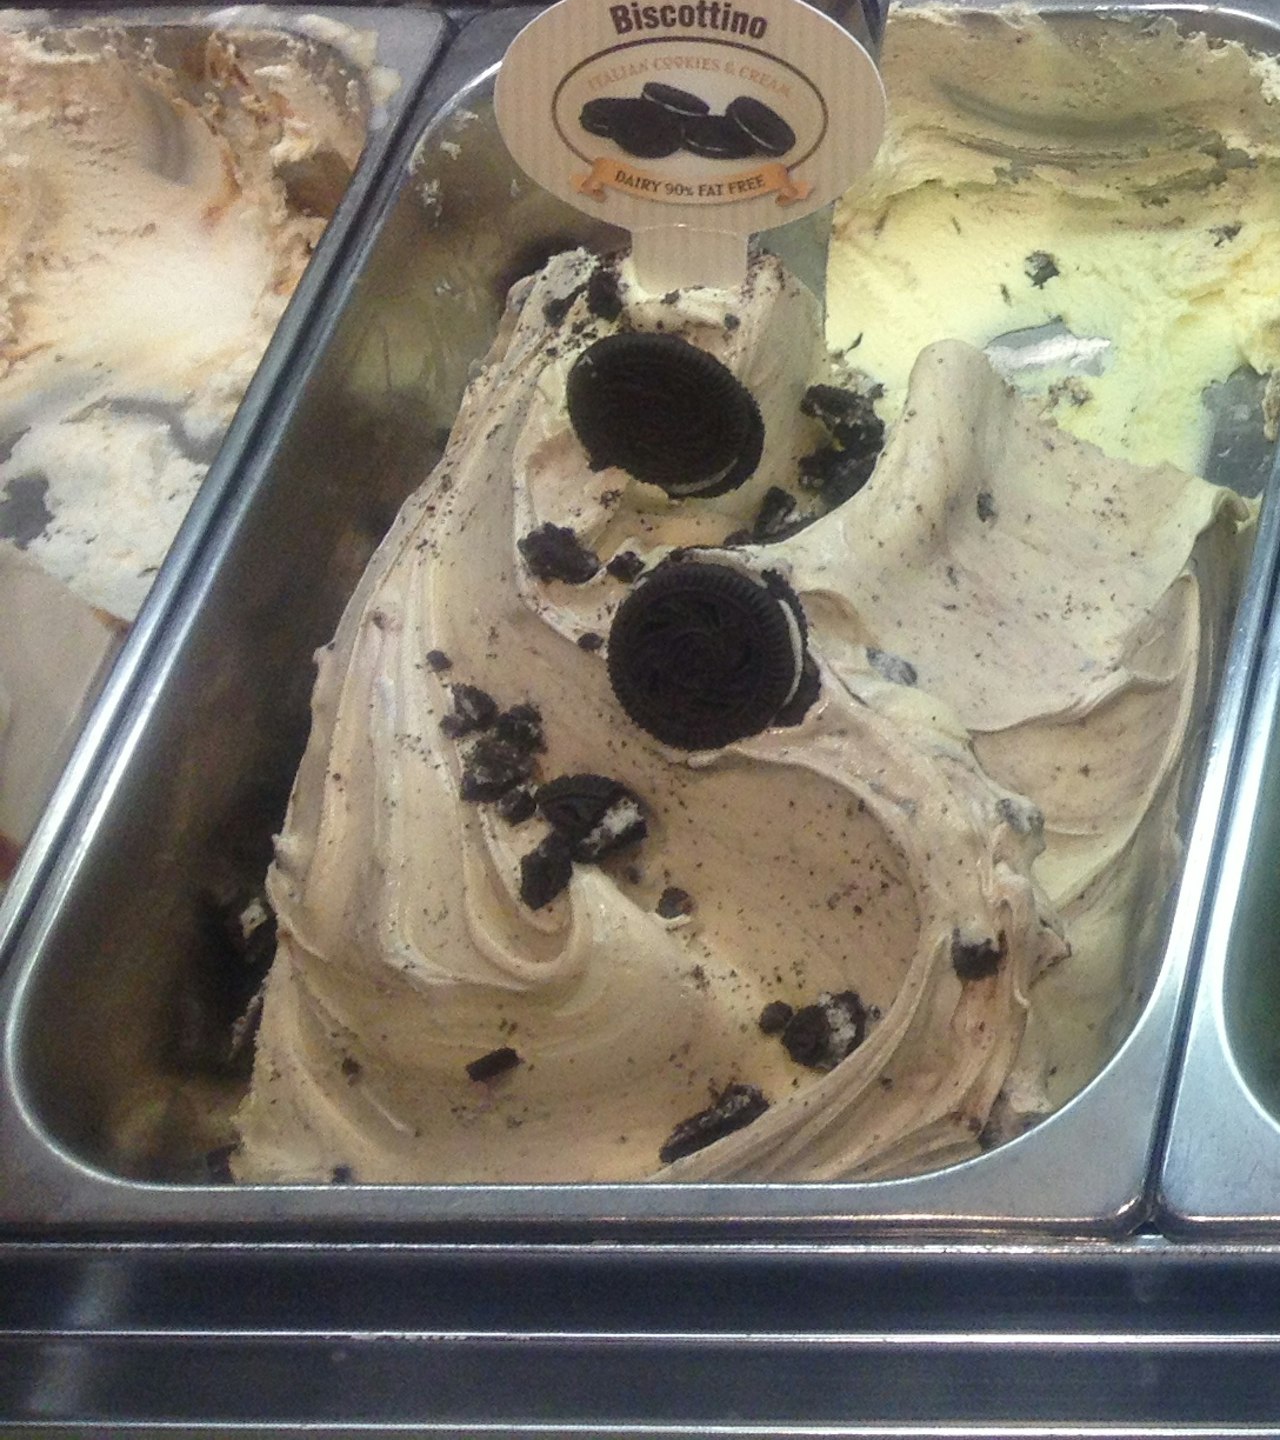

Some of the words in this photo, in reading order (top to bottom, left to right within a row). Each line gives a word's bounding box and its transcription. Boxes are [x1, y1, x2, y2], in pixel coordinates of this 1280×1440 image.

[609, 0, 768, 39] Biscottino
[587, 58, 649, 91] ITALIAN
[653, 55, 721, 71] COOKIES
[738, 67, 793, 97] CREAM
[614, 169, 661, 193] DAIRY
[664, 183, 694, 196] 90%
[698, 183, 724, 197] FAT
[728, 174, 766, 195] FREE
